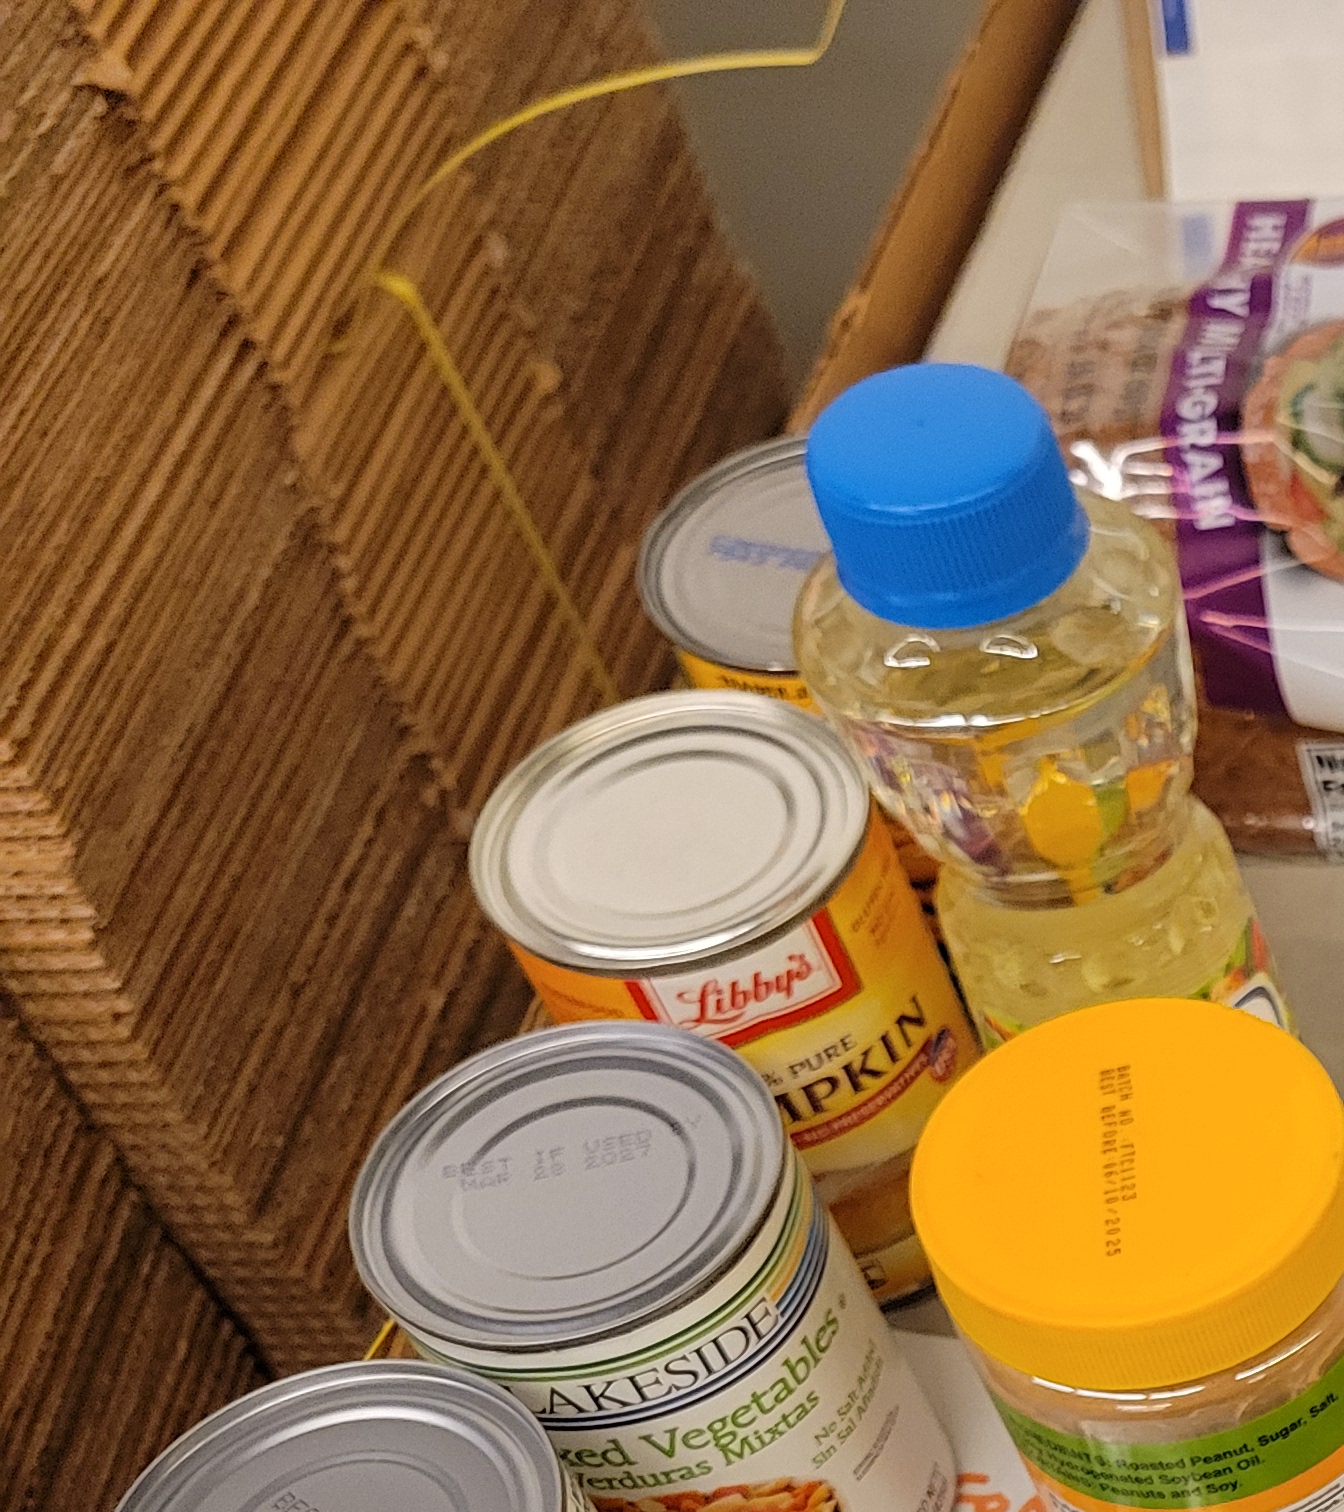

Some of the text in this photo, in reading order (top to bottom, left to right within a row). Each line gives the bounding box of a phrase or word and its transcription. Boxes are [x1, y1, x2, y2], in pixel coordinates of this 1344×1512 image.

[674, 953, 813, 1031] Libby's
[775, 994, 928, 1124] MPKIN
[787, 1034, 859, 1078] PURE
[640, 1307, 840, 1459] Vegetables
[720, 1389, 820, 1468] Mixtas
[812, 1444, 837, 1470] Sin
[814, 1422, 838, 1447] No
[1117, 1393, 1339, 1473] Roasted Peanut, Sugar, Salt.
[1099, 1478, 1241, 1501] Peanuts Soy.
[1158, 1453, 1265, 1487] Soybean Oil.
